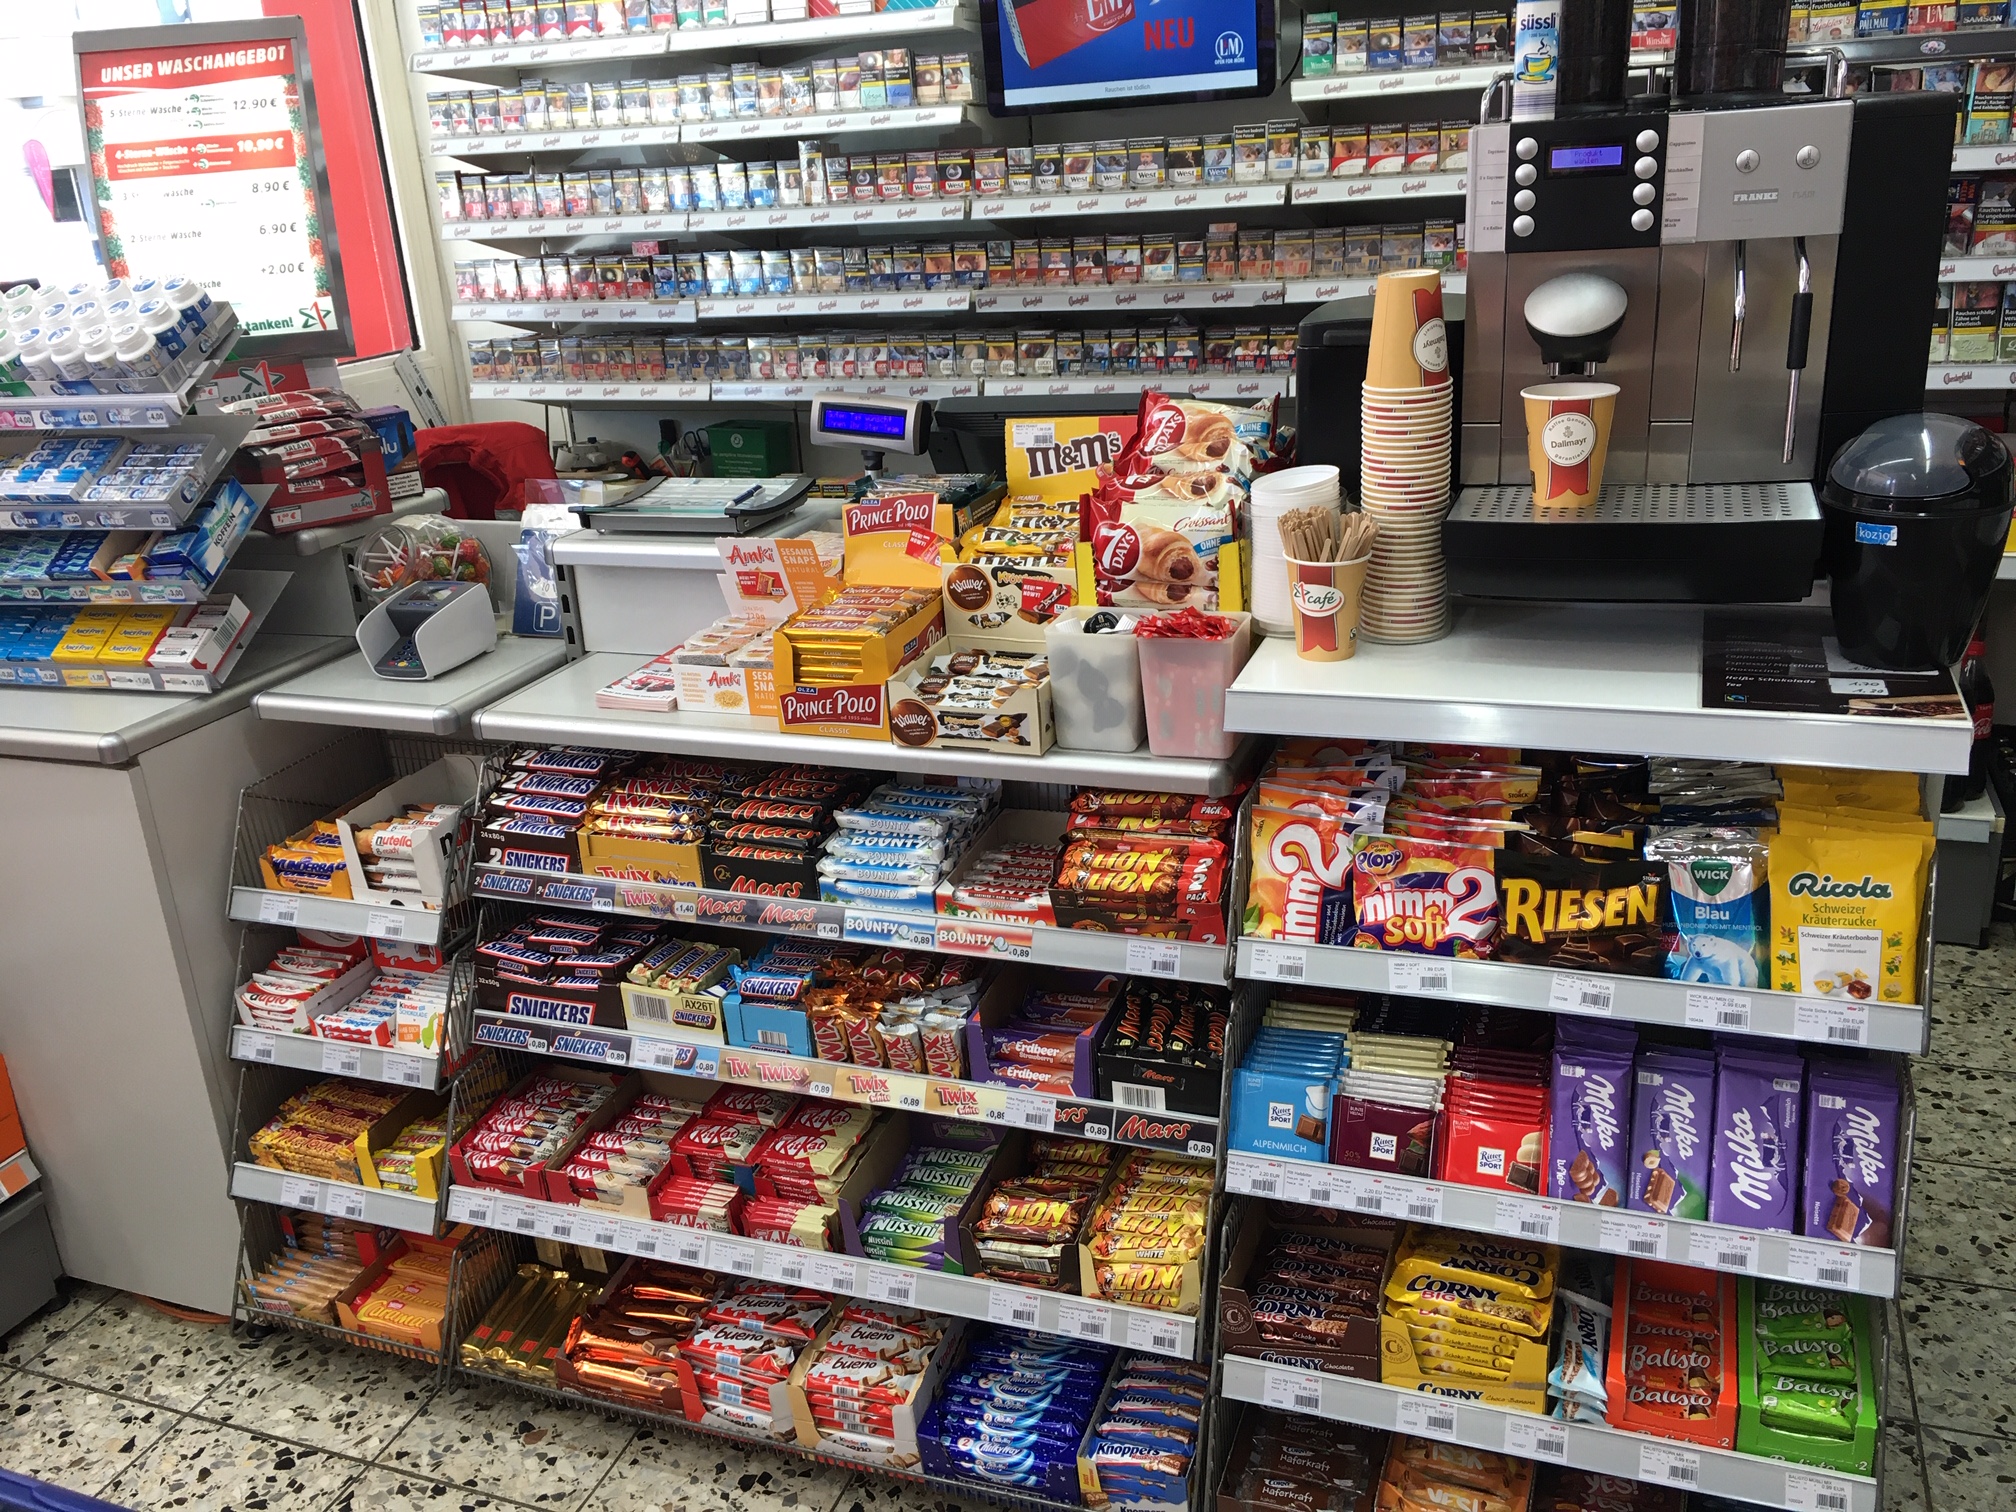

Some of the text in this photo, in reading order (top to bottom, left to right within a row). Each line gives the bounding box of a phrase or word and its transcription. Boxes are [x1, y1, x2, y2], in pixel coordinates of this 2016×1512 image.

[1812, 1, 1850, 9] Fruchtbarkeit
[1520, 13, 1556, 32] süssli
[1859, 18, 1889, 29] PALL MALL
[1963, 14, 2002, 24] SAMSON
[1144, 17, 1195, 51] NEU
[101, 45, 287, 83] UNSER WASCHANGEBOT
[1412, 55, 1434, 63] Winston
[270, 98, 277, 108] €
[1574, 150, 1603, 158] Produkt
[1136, 170, 1158, 181] West
[1175, 169, 1196, 180] West
[283, 181, 289, 191] €
[1733, 190, 1778, 203] FRANKE
[1978, 206, 1999, 215] Rauchen
[289, 222, 297, 233] €
[297, 262, 305, 273] €
[1955, 309, 1997, 318] Rauchen schädigt
[1955, 314, 1969, 322] Zähne
[246, 317, 294, 332] tanken!
[1954, 319, 1981, 327] Zahnfleisch
[254, 397, 281, 405] SALAMI
[270, 411, 297, 420] SALAMI
[1241, 423, 1261, 432] OHNE
[1547, 417, 1587, 433] Kaffee Genuss
[284, 442, 311, 451] SALAMI
[1551, 438, 1587, 451] Dallmayr
[850, 501, 929, 530] PRINCE POLO
[212, 512, 237, 547] KOFFEIN
[1173, 514, 1232, 532] Croissant
[1859, 528, 1896, 541] kozio
[1112, 531, 1135, 569] DAYS
[1201, 538, 1221, 550] OHNE
[726, 545, 775, 566] Amki
[781, 548, 813, 556] SESAME
[784, 556, 816, 564] SNAPS
[1308, 593, 1336, 606] café
[707, 671, 741, 688] Amki
[787, 690, 876, 719] PRINCE POLO
[819, 726, 850, 734] CLASSIC
[481, 831, 505, 841] 24x80g
[1695, 870, 1729, 879] WICK
[482, 877, 531, 893] SNICKERS
[1087, 871, 1162, 893] LION
[1789, 873, 1891, 898] Ricola
[621, 889, 657, 907] Twix
[1363, 868, 1498, 940] nimm 2
[698, 895, 747, 916] Mars
[1501, 876, 1659, 944] RIESEN
[1812, 903, 1866, 915] Schweizer
[759, 903, 817, 924] Mars
[1695, 907, 1729, 920] Blau
[846, 918, 898, 934] BOUNTY
[1385, 906, 1447, 948] soft
[1802, 915, 1877, 928] Kräuterzucker
[939, 931, 993, 945] BOUNTY
[1801, 931, 1879, 942] Schweizer Kräuterbonbon
[684, 999, 714, 1011] AX26T
[344, 1018, 372, 1028] Riegel
[477, 1027, 529, 1045] SNICKERS
[555, 1039, 608, 1057] SNICKERS
[1015, 1041, 1060, 1057] Erdbeer
[757, 1062, 800, 1081] Twix
[1007, 1066, 1052, 1082] Erdbeer
[850, 1075, 889, 1093] Twix
[1271, 1106, 1291, 1116] Ritter
[1583, 1074, 1620, 1151] Milka
[1270, 1115, 1291, 1123] SPORT
[1117, 1115, 1192, 1139] Mars
[689, 1124, 738, 1144] KitKat
[1253, 1140, 1307, 1154] ALPENMILCH
[1846, 1106, 1886, 1187] Milka
[1481, 1152, 1501, 1162] Ritter
[1725, 1107, 1772, 1210] Milka
[1479, 1161, 1502, 1170] SPORT
[1006, 1204, 1069, 1226] LION
[1135, 1249, 1164, 1259] WHITE
[1115, 1266, 1181, 1289] LION
[1407, 1274, 1501, 1302] CORNY
[1420, 1291, 1456, 1301] BIG
[714, 1328, 764, 1341] bueno
[1762, 1340, 1841, 1356] Balisto
[1630, 1345, 1711, 1368] Balisto
[832, 1358, 877, 1370] bueno
[1629, 1385, 1712, 1406] Balisto
[1099, 1442, 1161, 1456] Knoppers
[1262, 1487, 1313, 1502] Haferkraft
